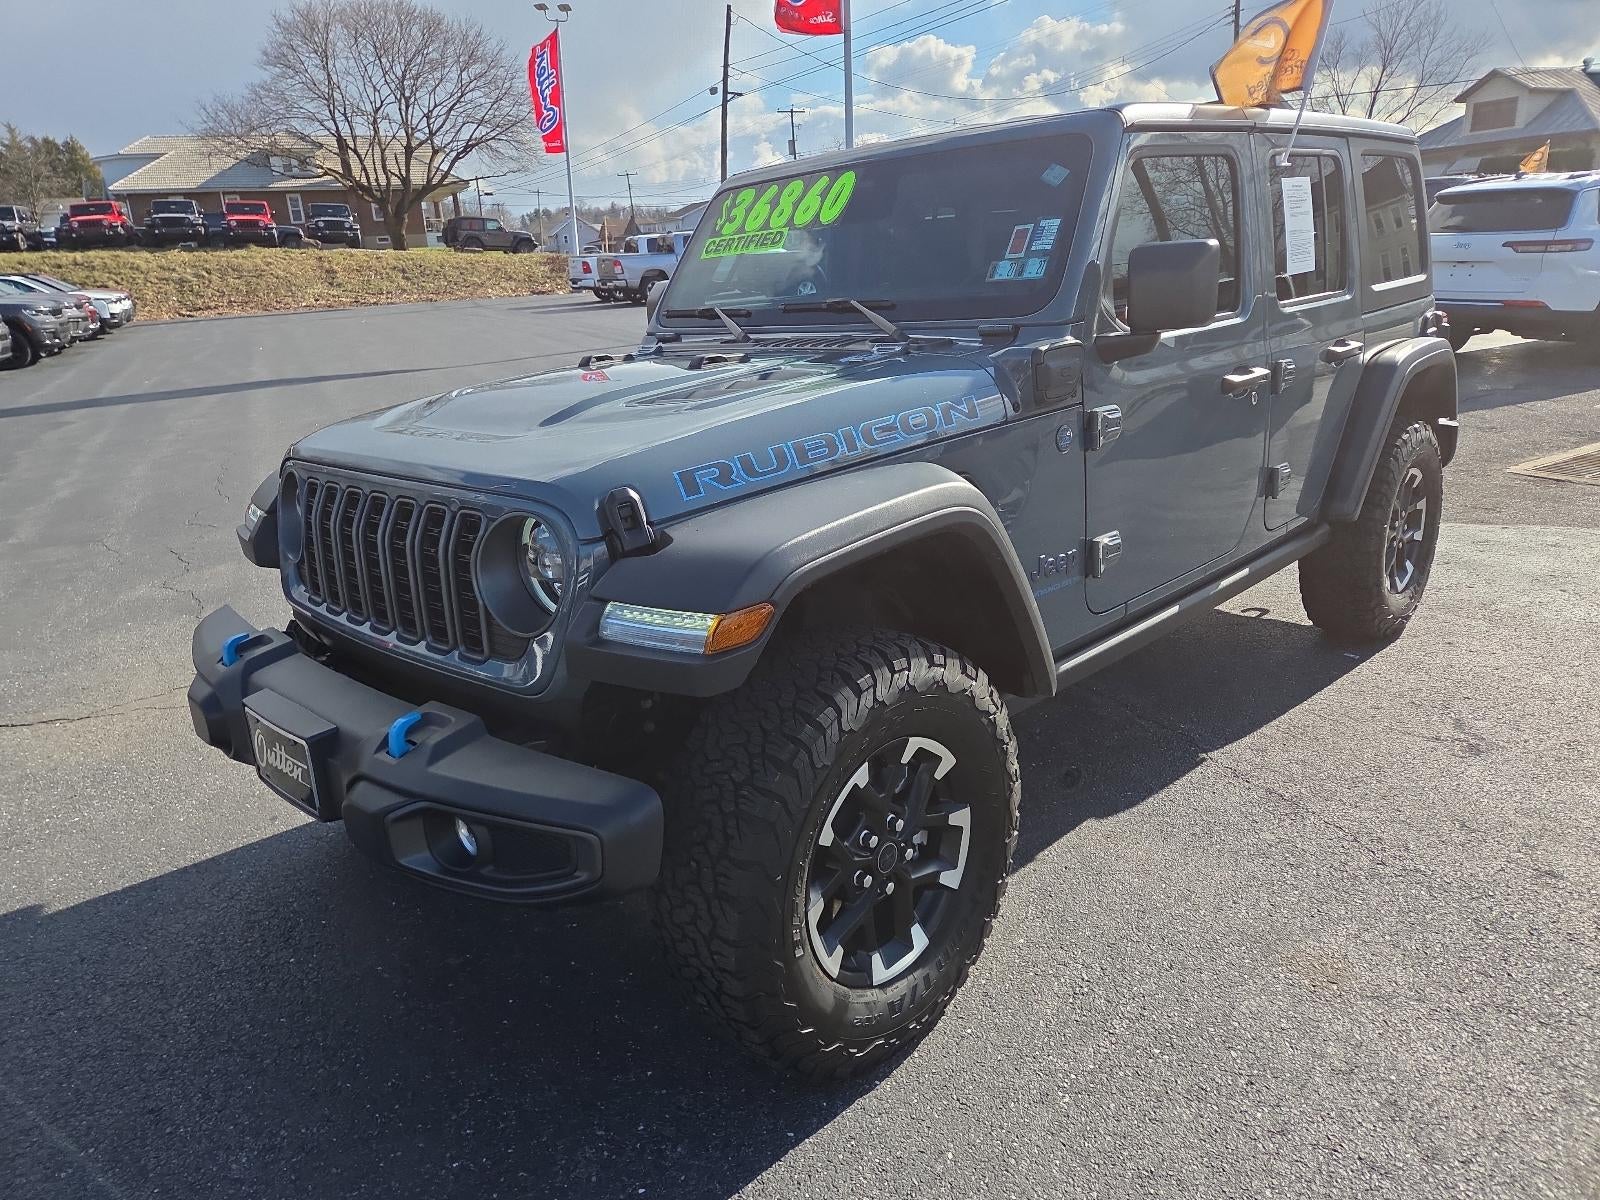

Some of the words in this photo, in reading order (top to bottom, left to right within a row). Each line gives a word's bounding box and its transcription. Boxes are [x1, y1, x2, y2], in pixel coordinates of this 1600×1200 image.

[715, 170, 857, 235] $36860
[704, 230, 785, 255] CERTIFIED
[673, 394, 982, 501] RUBICON
[1030, 548, 1078, 582] Jeep
[254, 728, 312, 788] Outten
